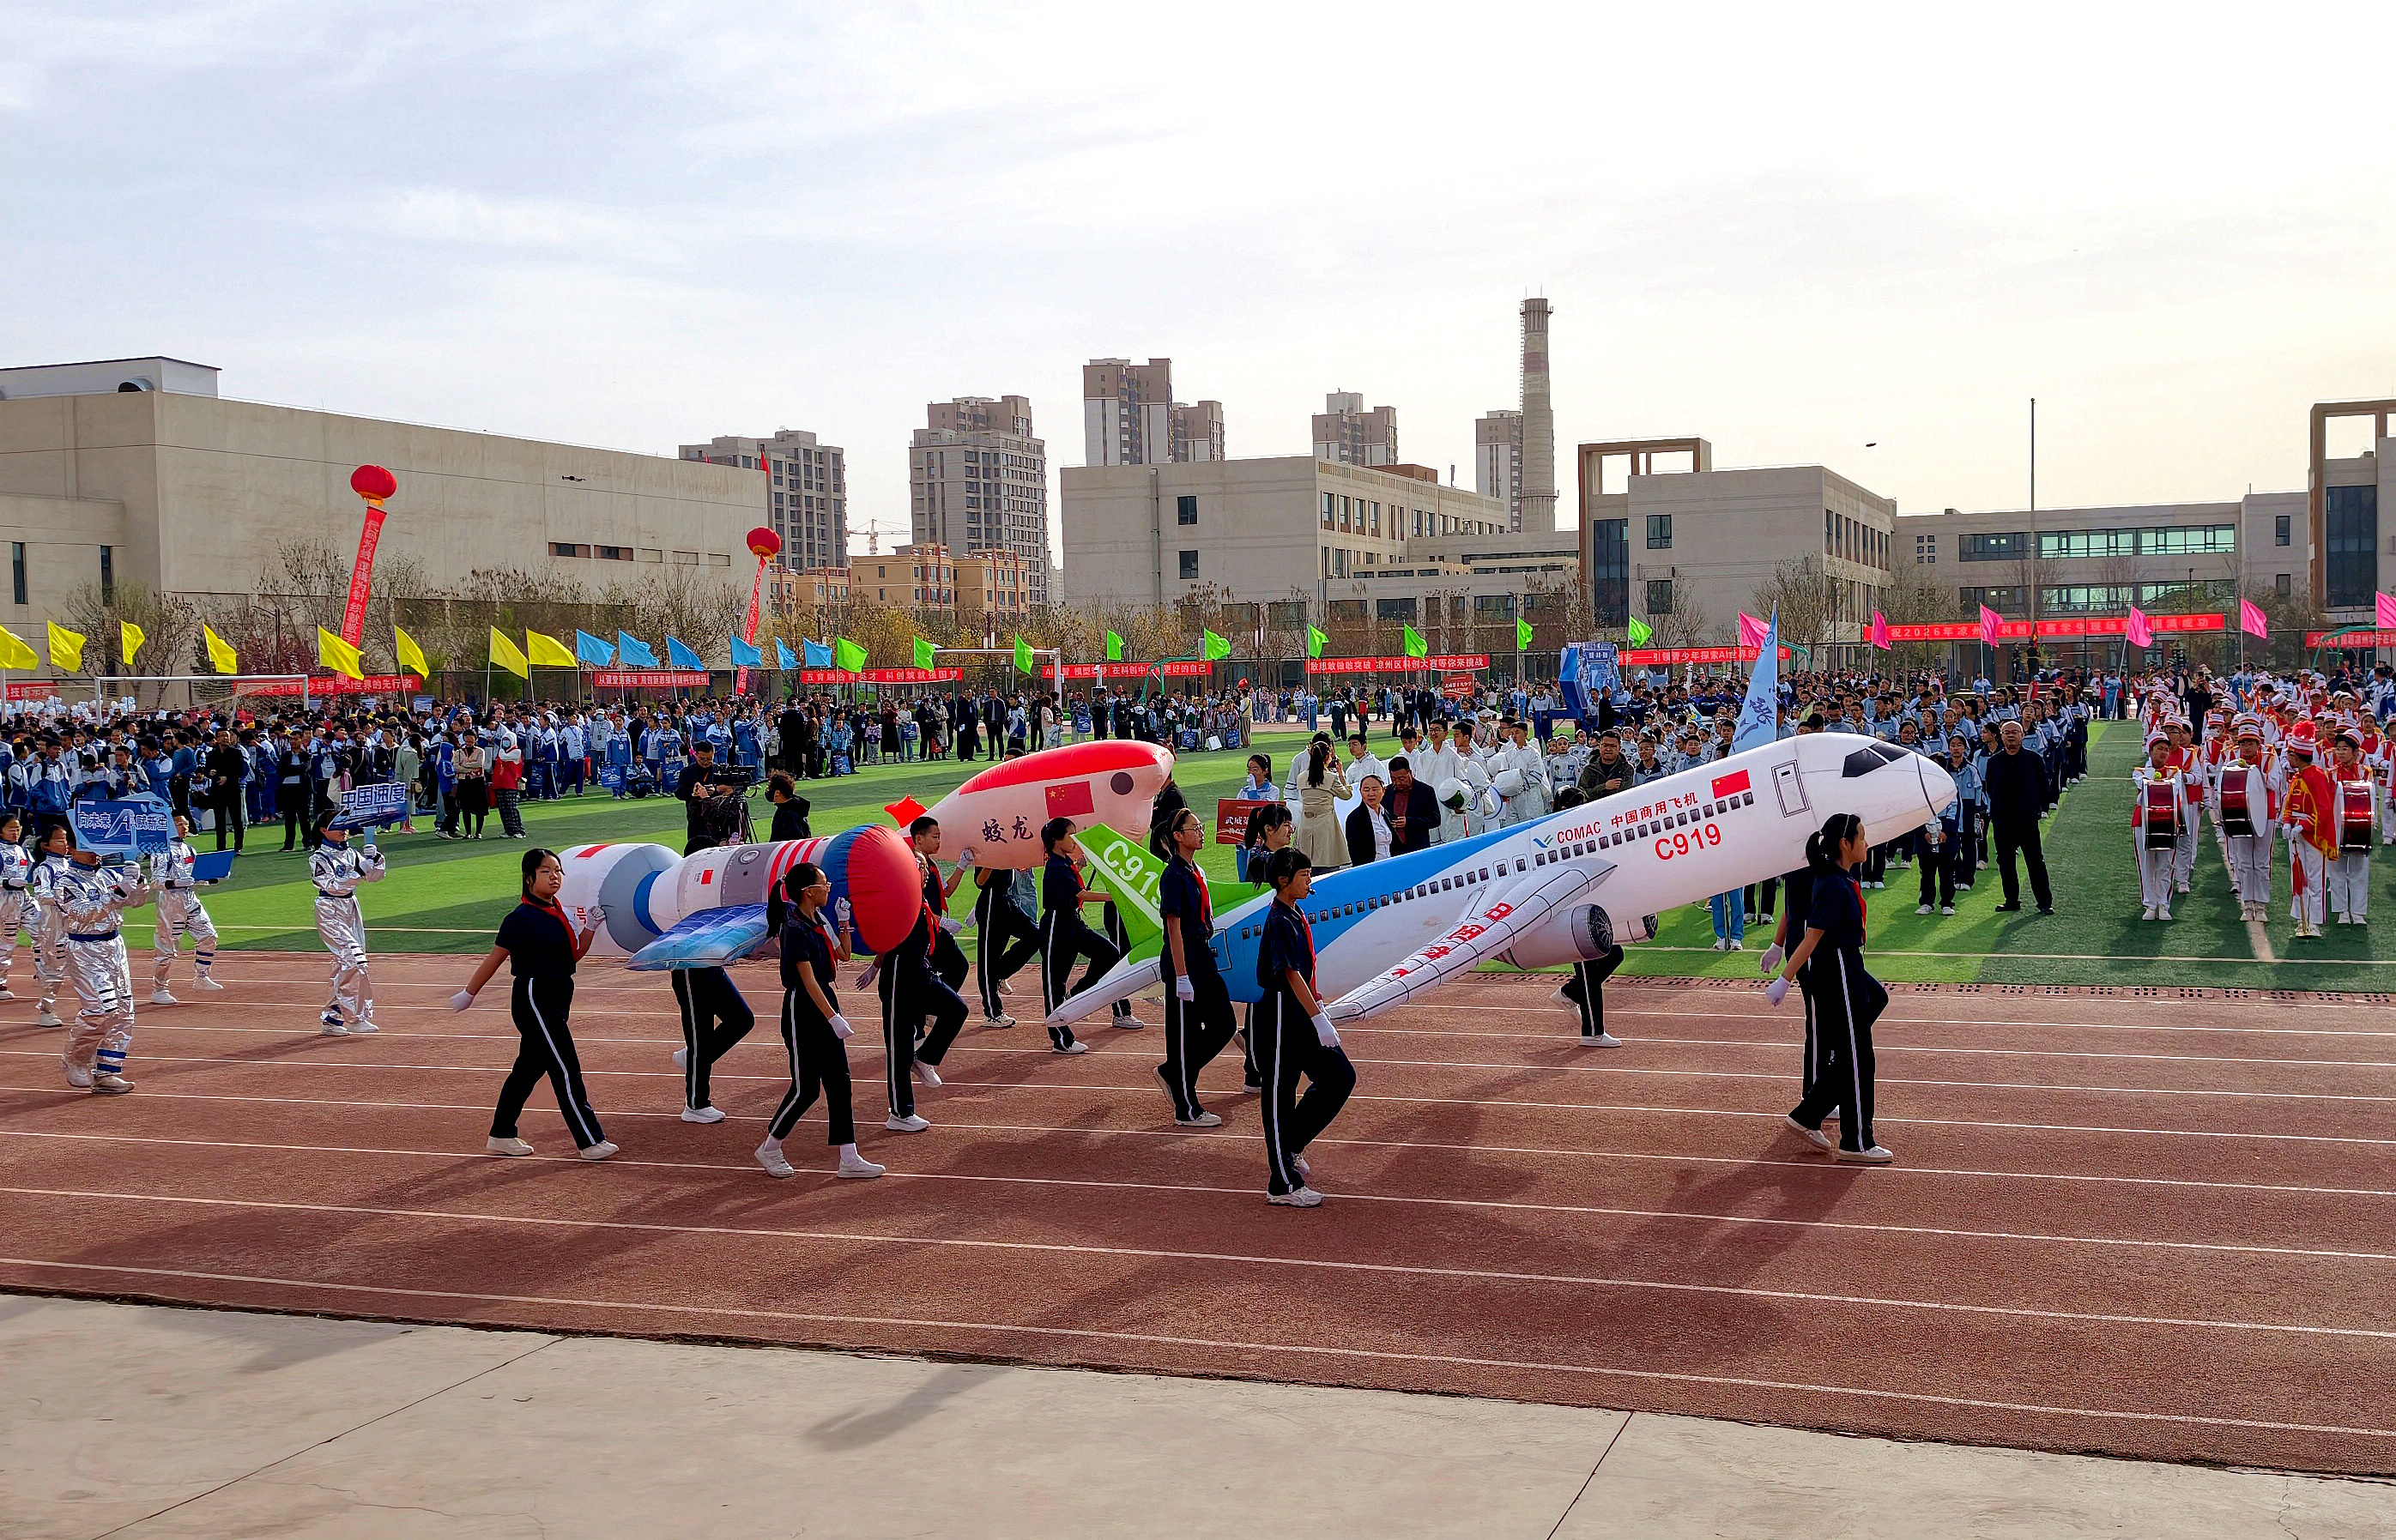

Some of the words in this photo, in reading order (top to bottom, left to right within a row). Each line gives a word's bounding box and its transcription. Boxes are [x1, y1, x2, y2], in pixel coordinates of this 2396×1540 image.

[1045, 667, 1069, 676] AI智
[1111, 664, 1206, 675] 在科创中更好的自己
[340, 781, 407, 809] 中国速度
[981, 814, 1034, 844] 蛟龙
[1557, 821, 1601, 844] COMAC
[1611, 792, 1698, 829] 中国商用飞机
[1655, 822, 1721, 861] C919
